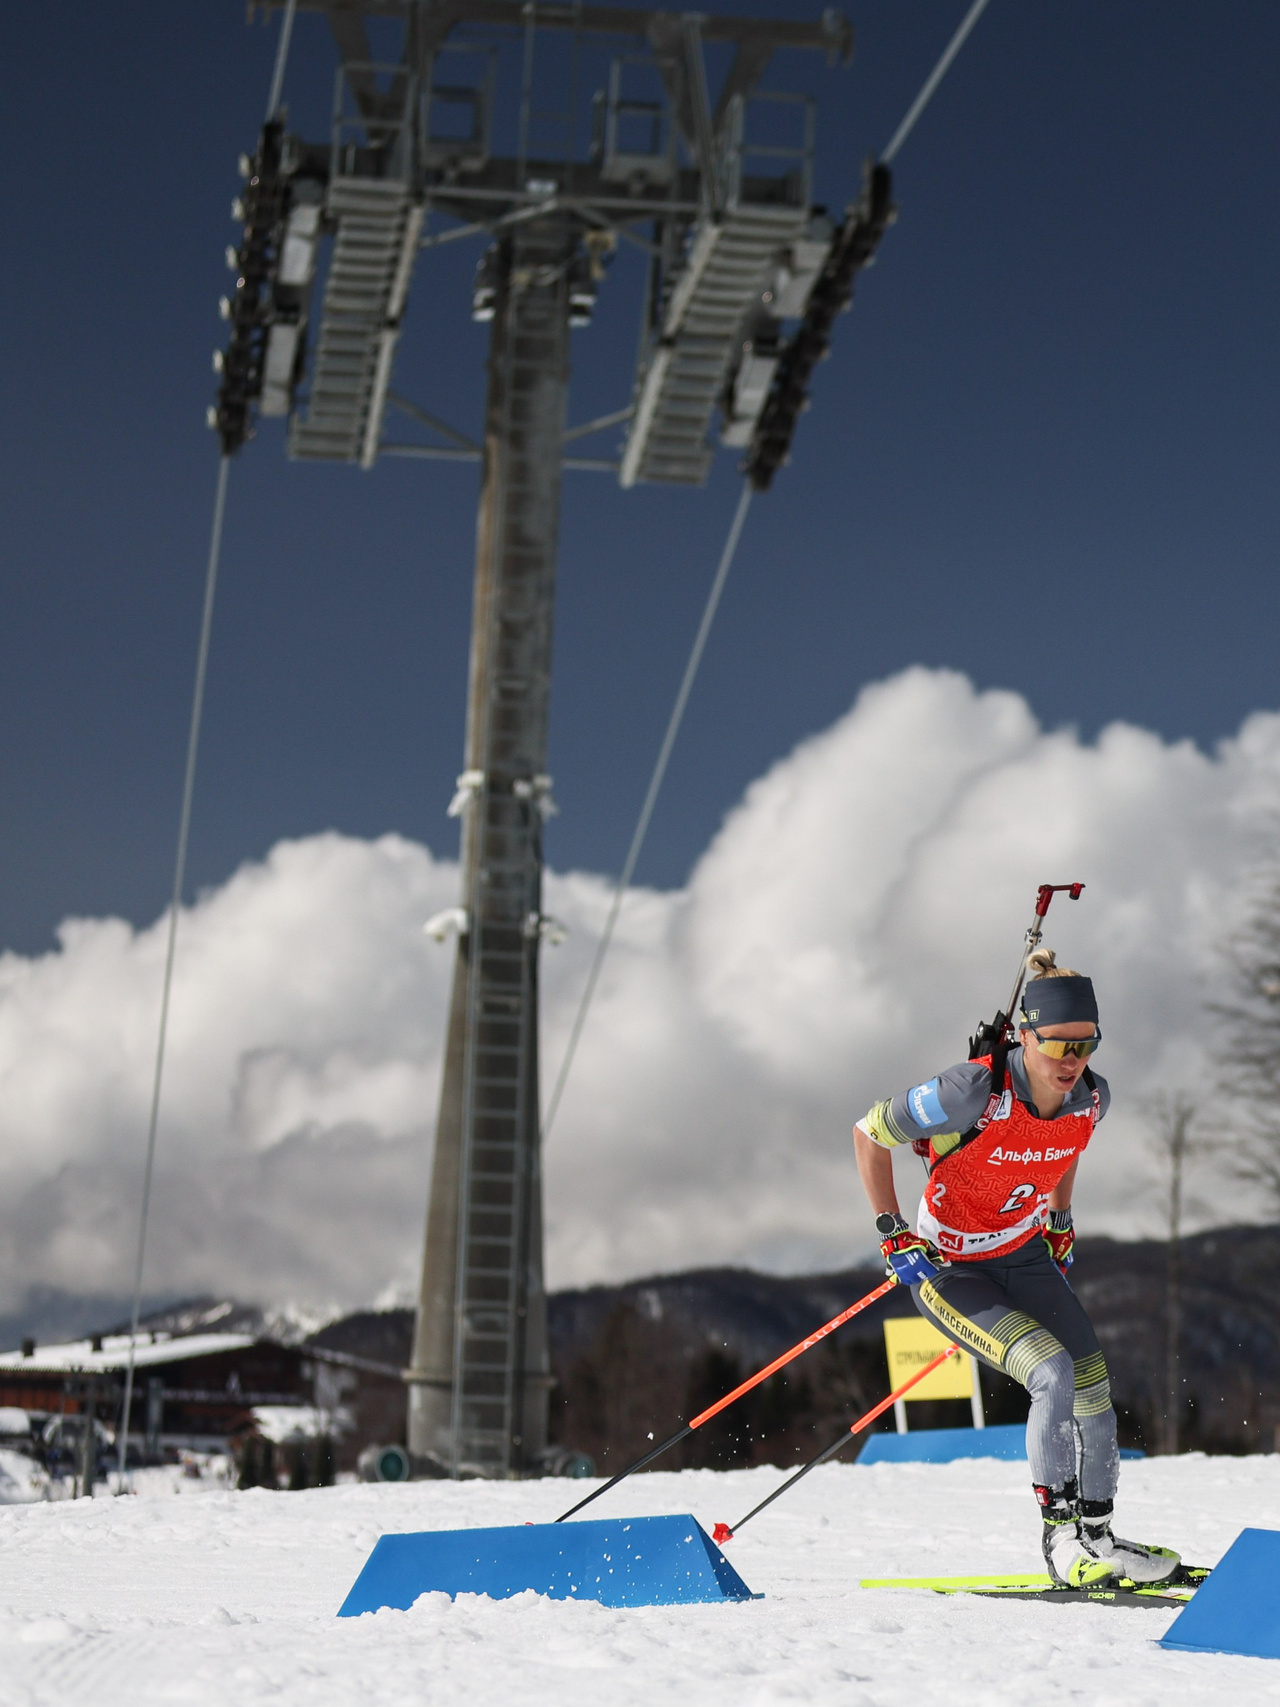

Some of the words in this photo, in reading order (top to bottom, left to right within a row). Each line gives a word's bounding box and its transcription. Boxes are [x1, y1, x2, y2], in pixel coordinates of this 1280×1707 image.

[987, 1146, 1042, 1165] Альфа
[1044, 1146, 1076, 1162] Банк
[932, 1183, 947, 1208] 2
[998, 1183, 1036, 1214] 2
[935, 1304, 998, 1358] «НАСЕДКИНА»
[1087, 1592, 1116, 1601] FISCHER
